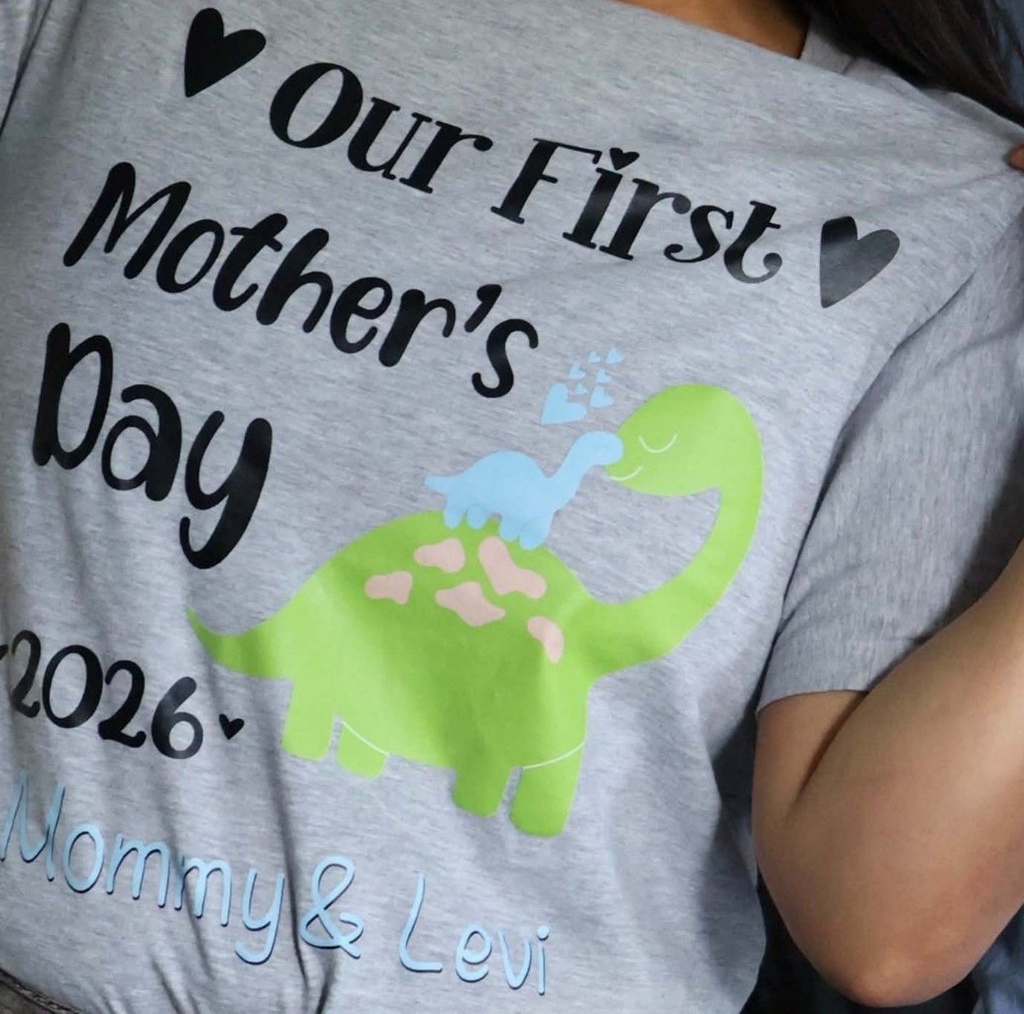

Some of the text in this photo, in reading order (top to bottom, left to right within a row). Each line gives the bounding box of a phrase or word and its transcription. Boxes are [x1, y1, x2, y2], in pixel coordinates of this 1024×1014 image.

[62, 161, 540, 399] Mother's
[269, 62, 784, 284] Our First
[32, 322, 273, 570] Day
[8, 629, 205, 760] 2026
[0, 769, 552, 996] Mommy & Levi
